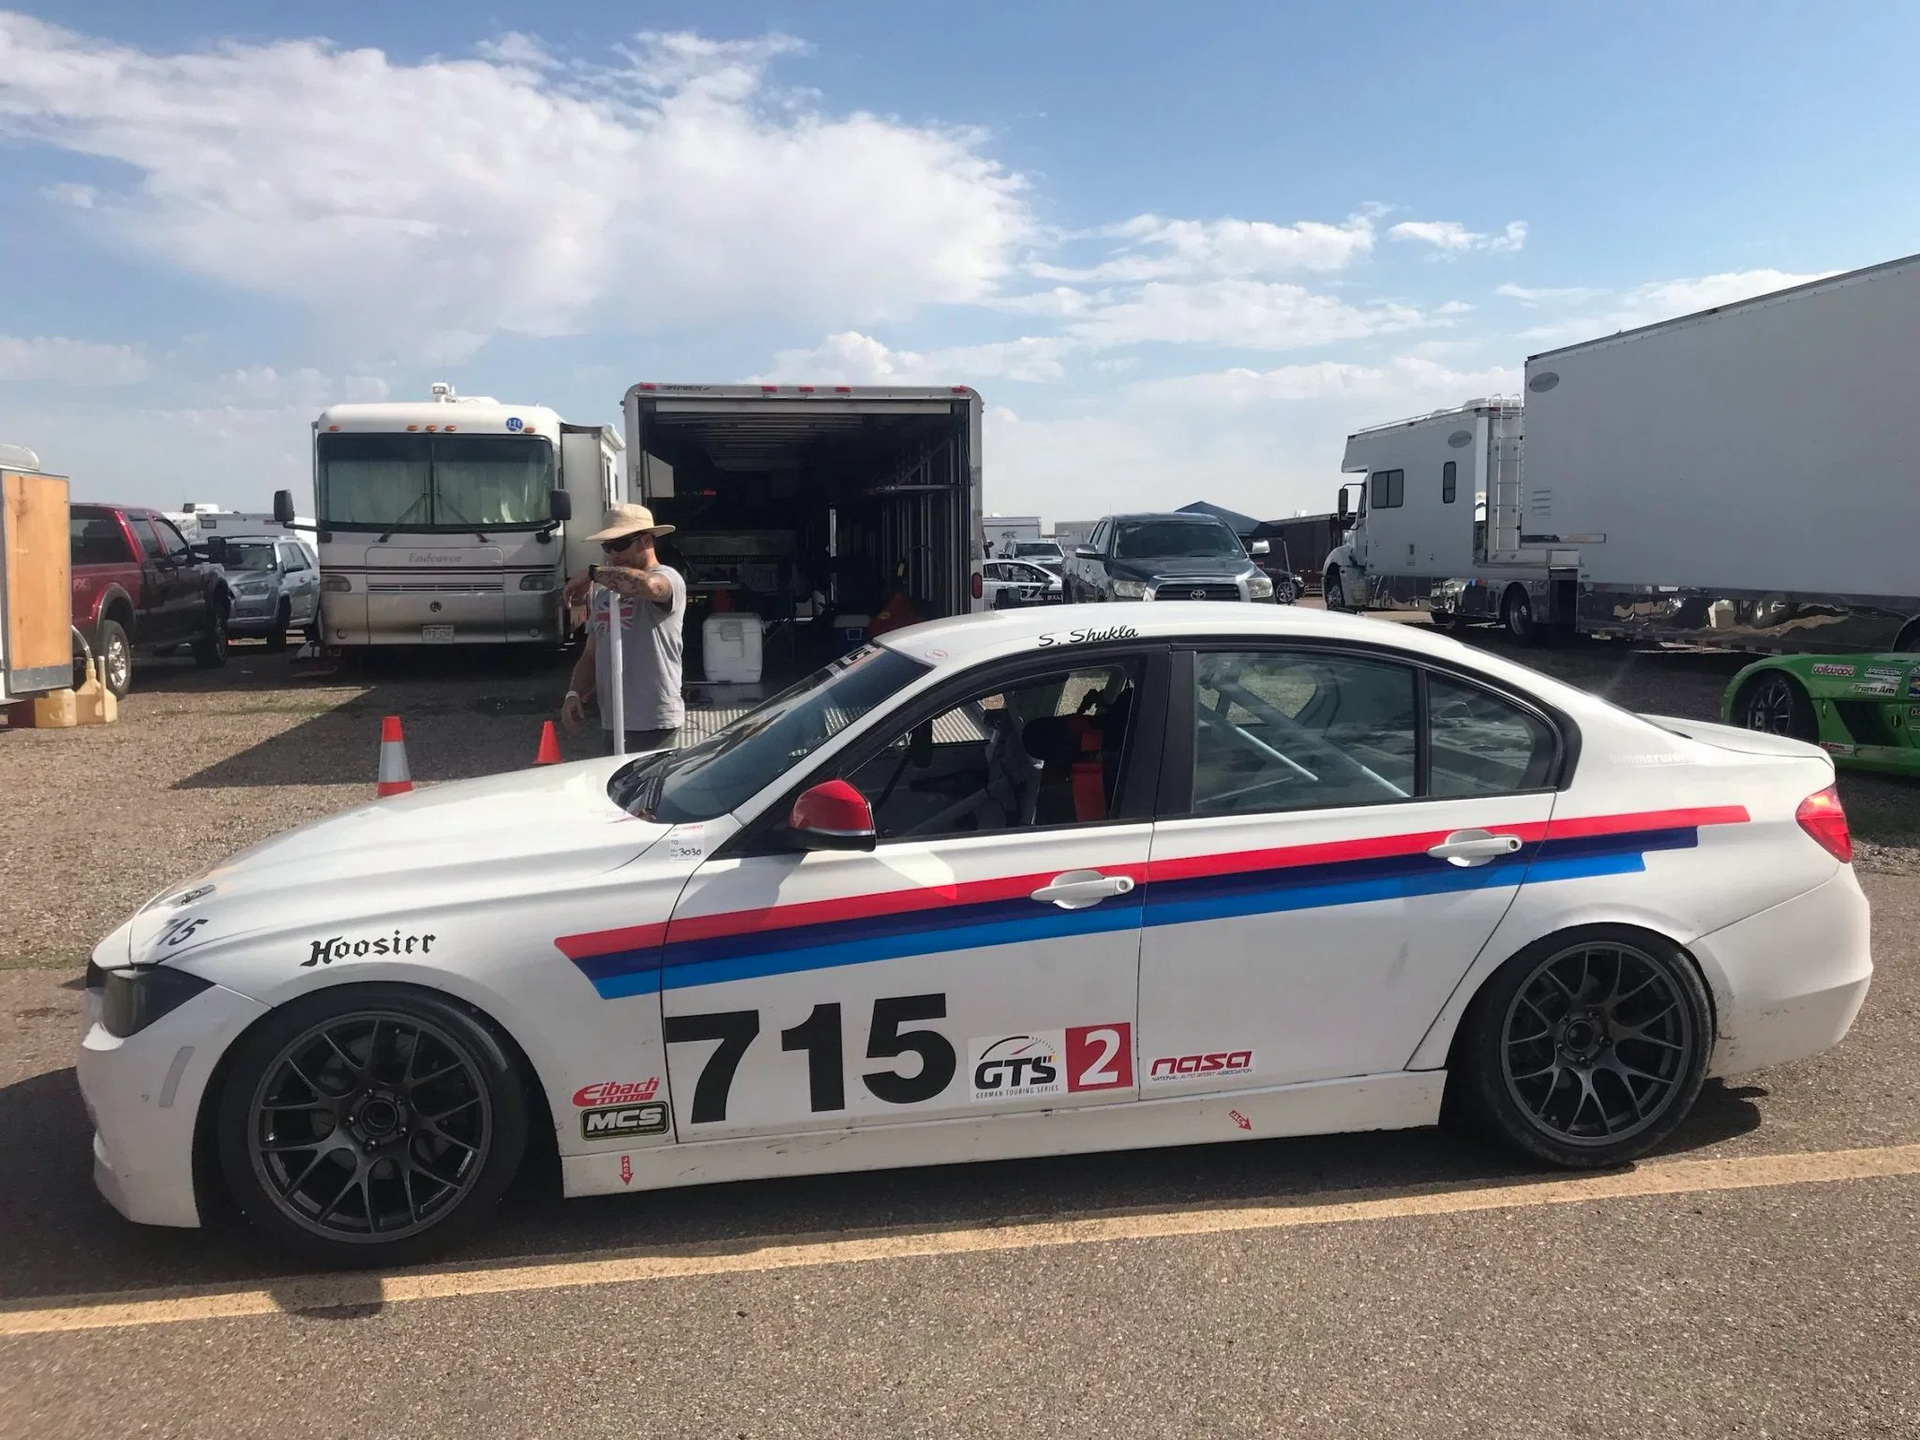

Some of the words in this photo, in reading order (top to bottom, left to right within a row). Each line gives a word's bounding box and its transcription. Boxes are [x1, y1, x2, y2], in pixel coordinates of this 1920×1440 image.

[408, 552, 463, 562] Endeavor
[1069, 625, 1139, 642] Shukla
[1879, 685, 1895, 694] Am
[680, 848, 702, 857] 3030
[299, 929, 437, 967] Hoosier
[664, 993, 957, 1124] 715
[1078, 1028, 1121, 1086] 2
[1150, 1051, 1253, 1076] nasa
[974, 1056, 1057, 1090] GTS
[1216, 1067, 1253, 1076] ASSOCIATION
[572, 1076, 660, 1107] Eibach
[975, 1089, 1003, 1099] GERMAN
[1005, 1087, 1034, 1097] TOURING
[1037, 1084, 1059, 1093] SERIES
[586, 1107, 663, 1132] MCS
[1229, 1110, 1248, 1127] JACK
